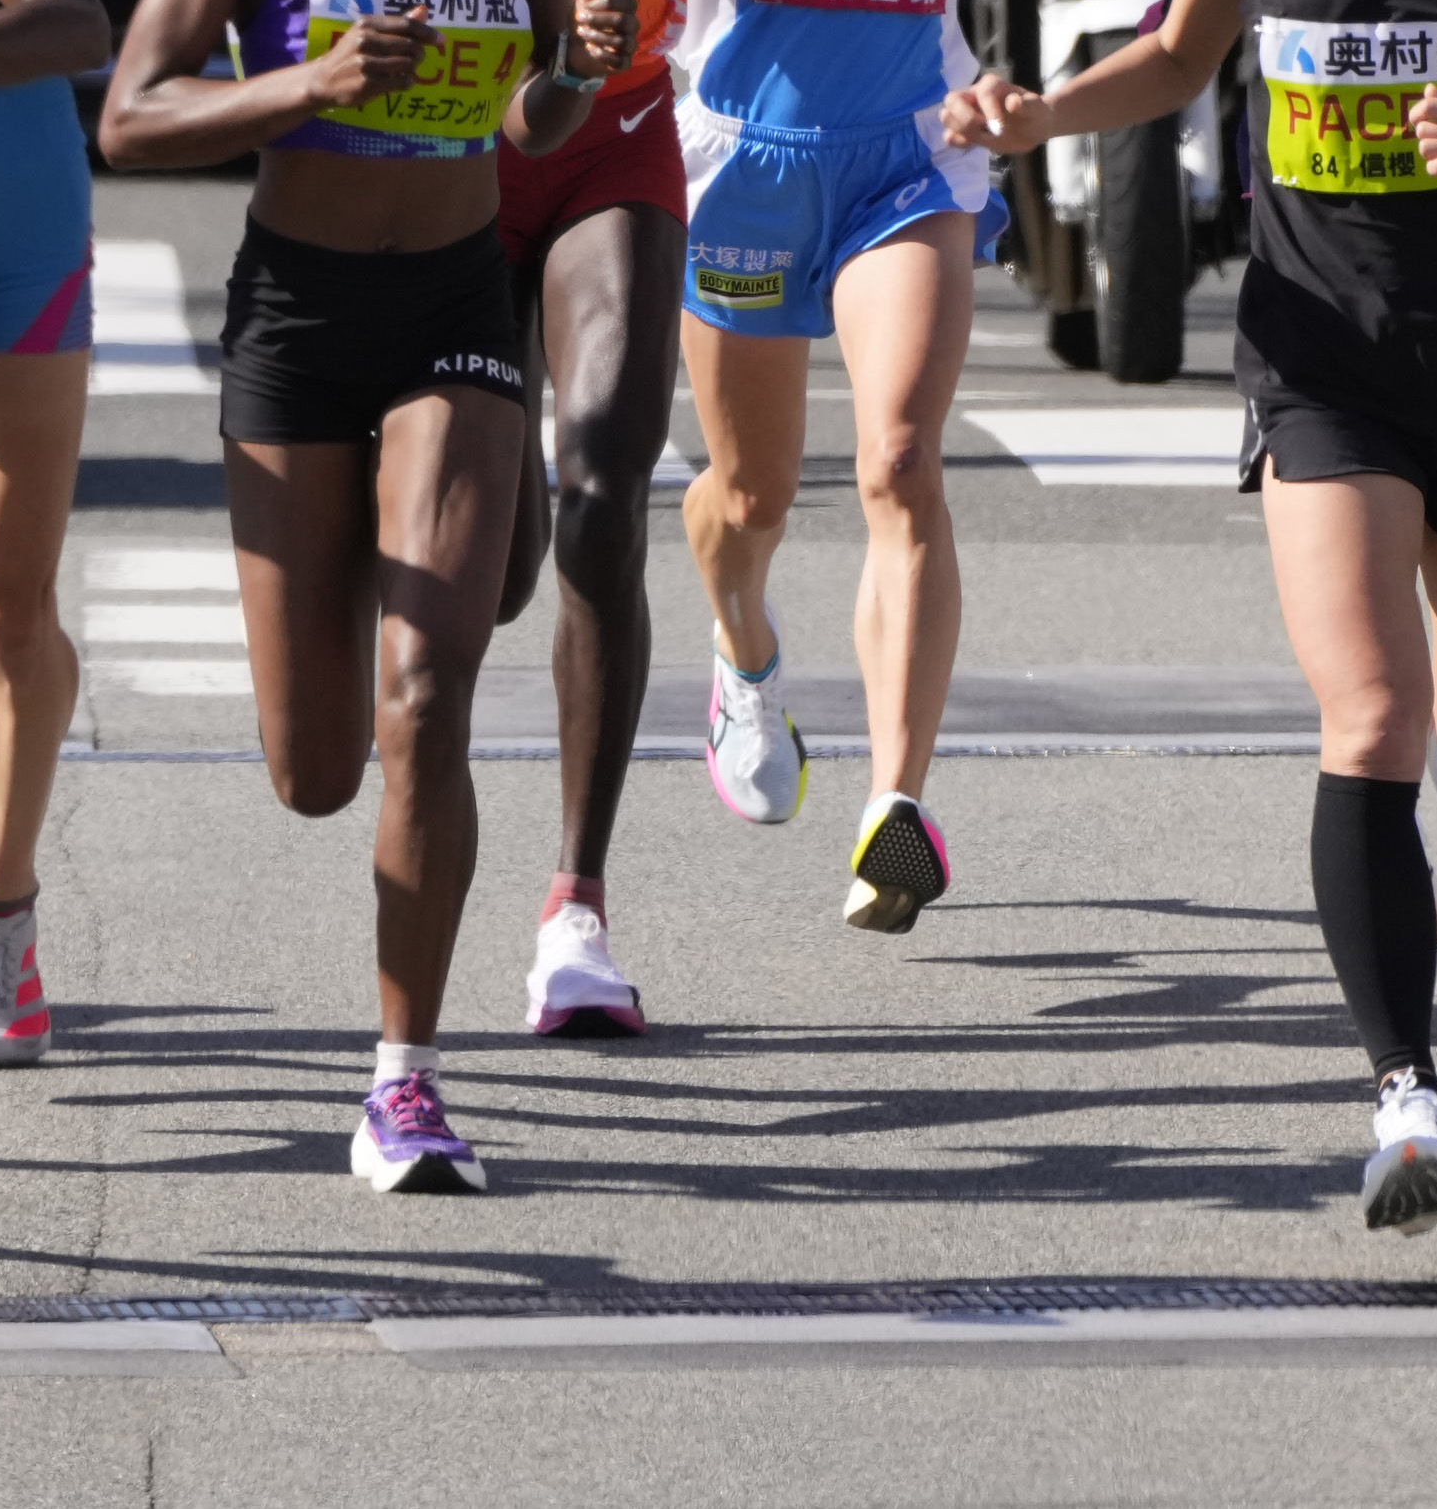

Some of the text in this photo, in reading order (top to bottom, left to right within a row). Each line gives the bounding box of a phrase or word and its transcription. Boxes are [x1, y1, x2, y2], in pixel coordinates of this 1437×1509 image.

[492, 42, 517, 85] 4
[1311, 152, 1339, 178] 84
[690, 241, 795, 271] 大塚製薬
[699, 273, 780, 293] BODYMAINTÉ
[434, 353, 523, 388] KIPRUN
